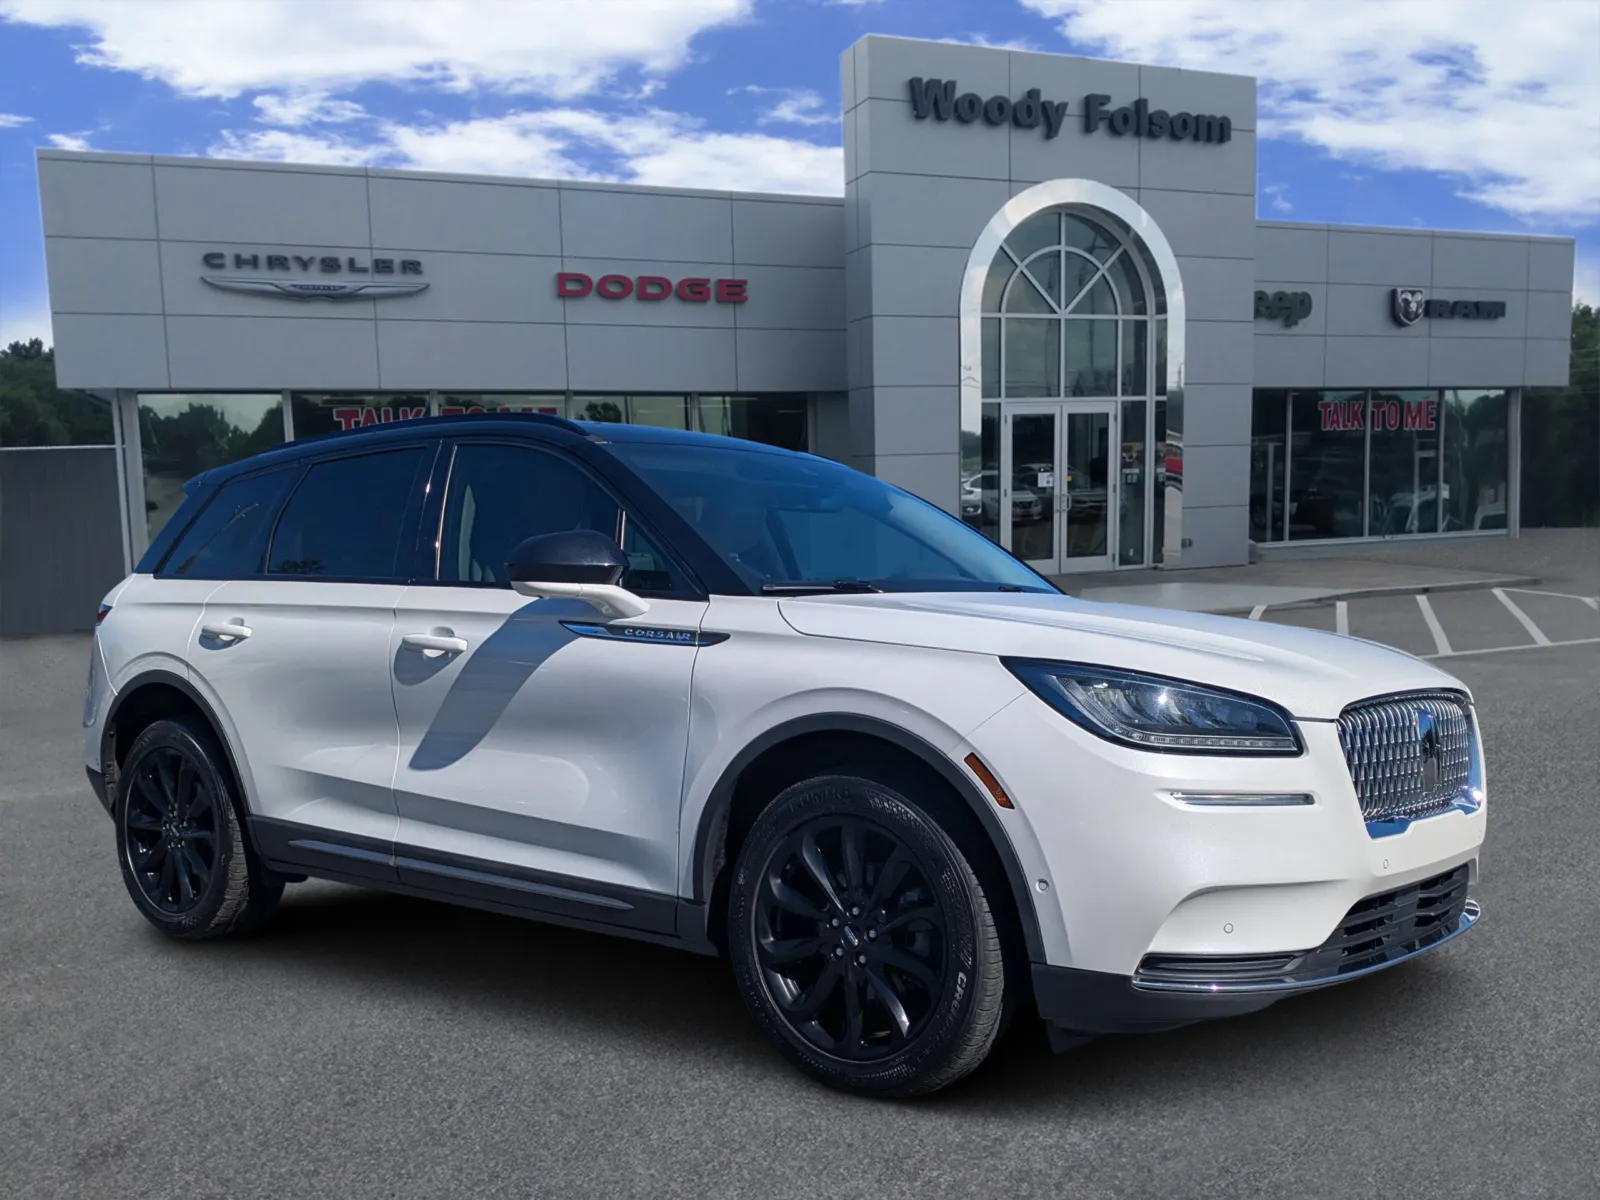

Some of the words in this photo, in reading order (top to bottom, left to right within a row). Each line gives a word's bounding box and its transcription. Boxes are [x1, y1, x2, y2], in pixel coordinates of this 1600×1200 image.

[908, 77, 1069, 140] Woody
[1083, 93, 1232, 143] Folsom
[202, 252, 423, 275] CHRYSLER
[556, 272, 748, 303] DODGE
[1254, 290, 1312, 328] eep
[1424, 299, 1506, 319] RAM
[1318, 400, 1364, 431] TALK
[1371, 400, 1400, 431] TO
[1403, 400, 1438, 431] ME
[624, 628, 691, 642] CORSAIR
